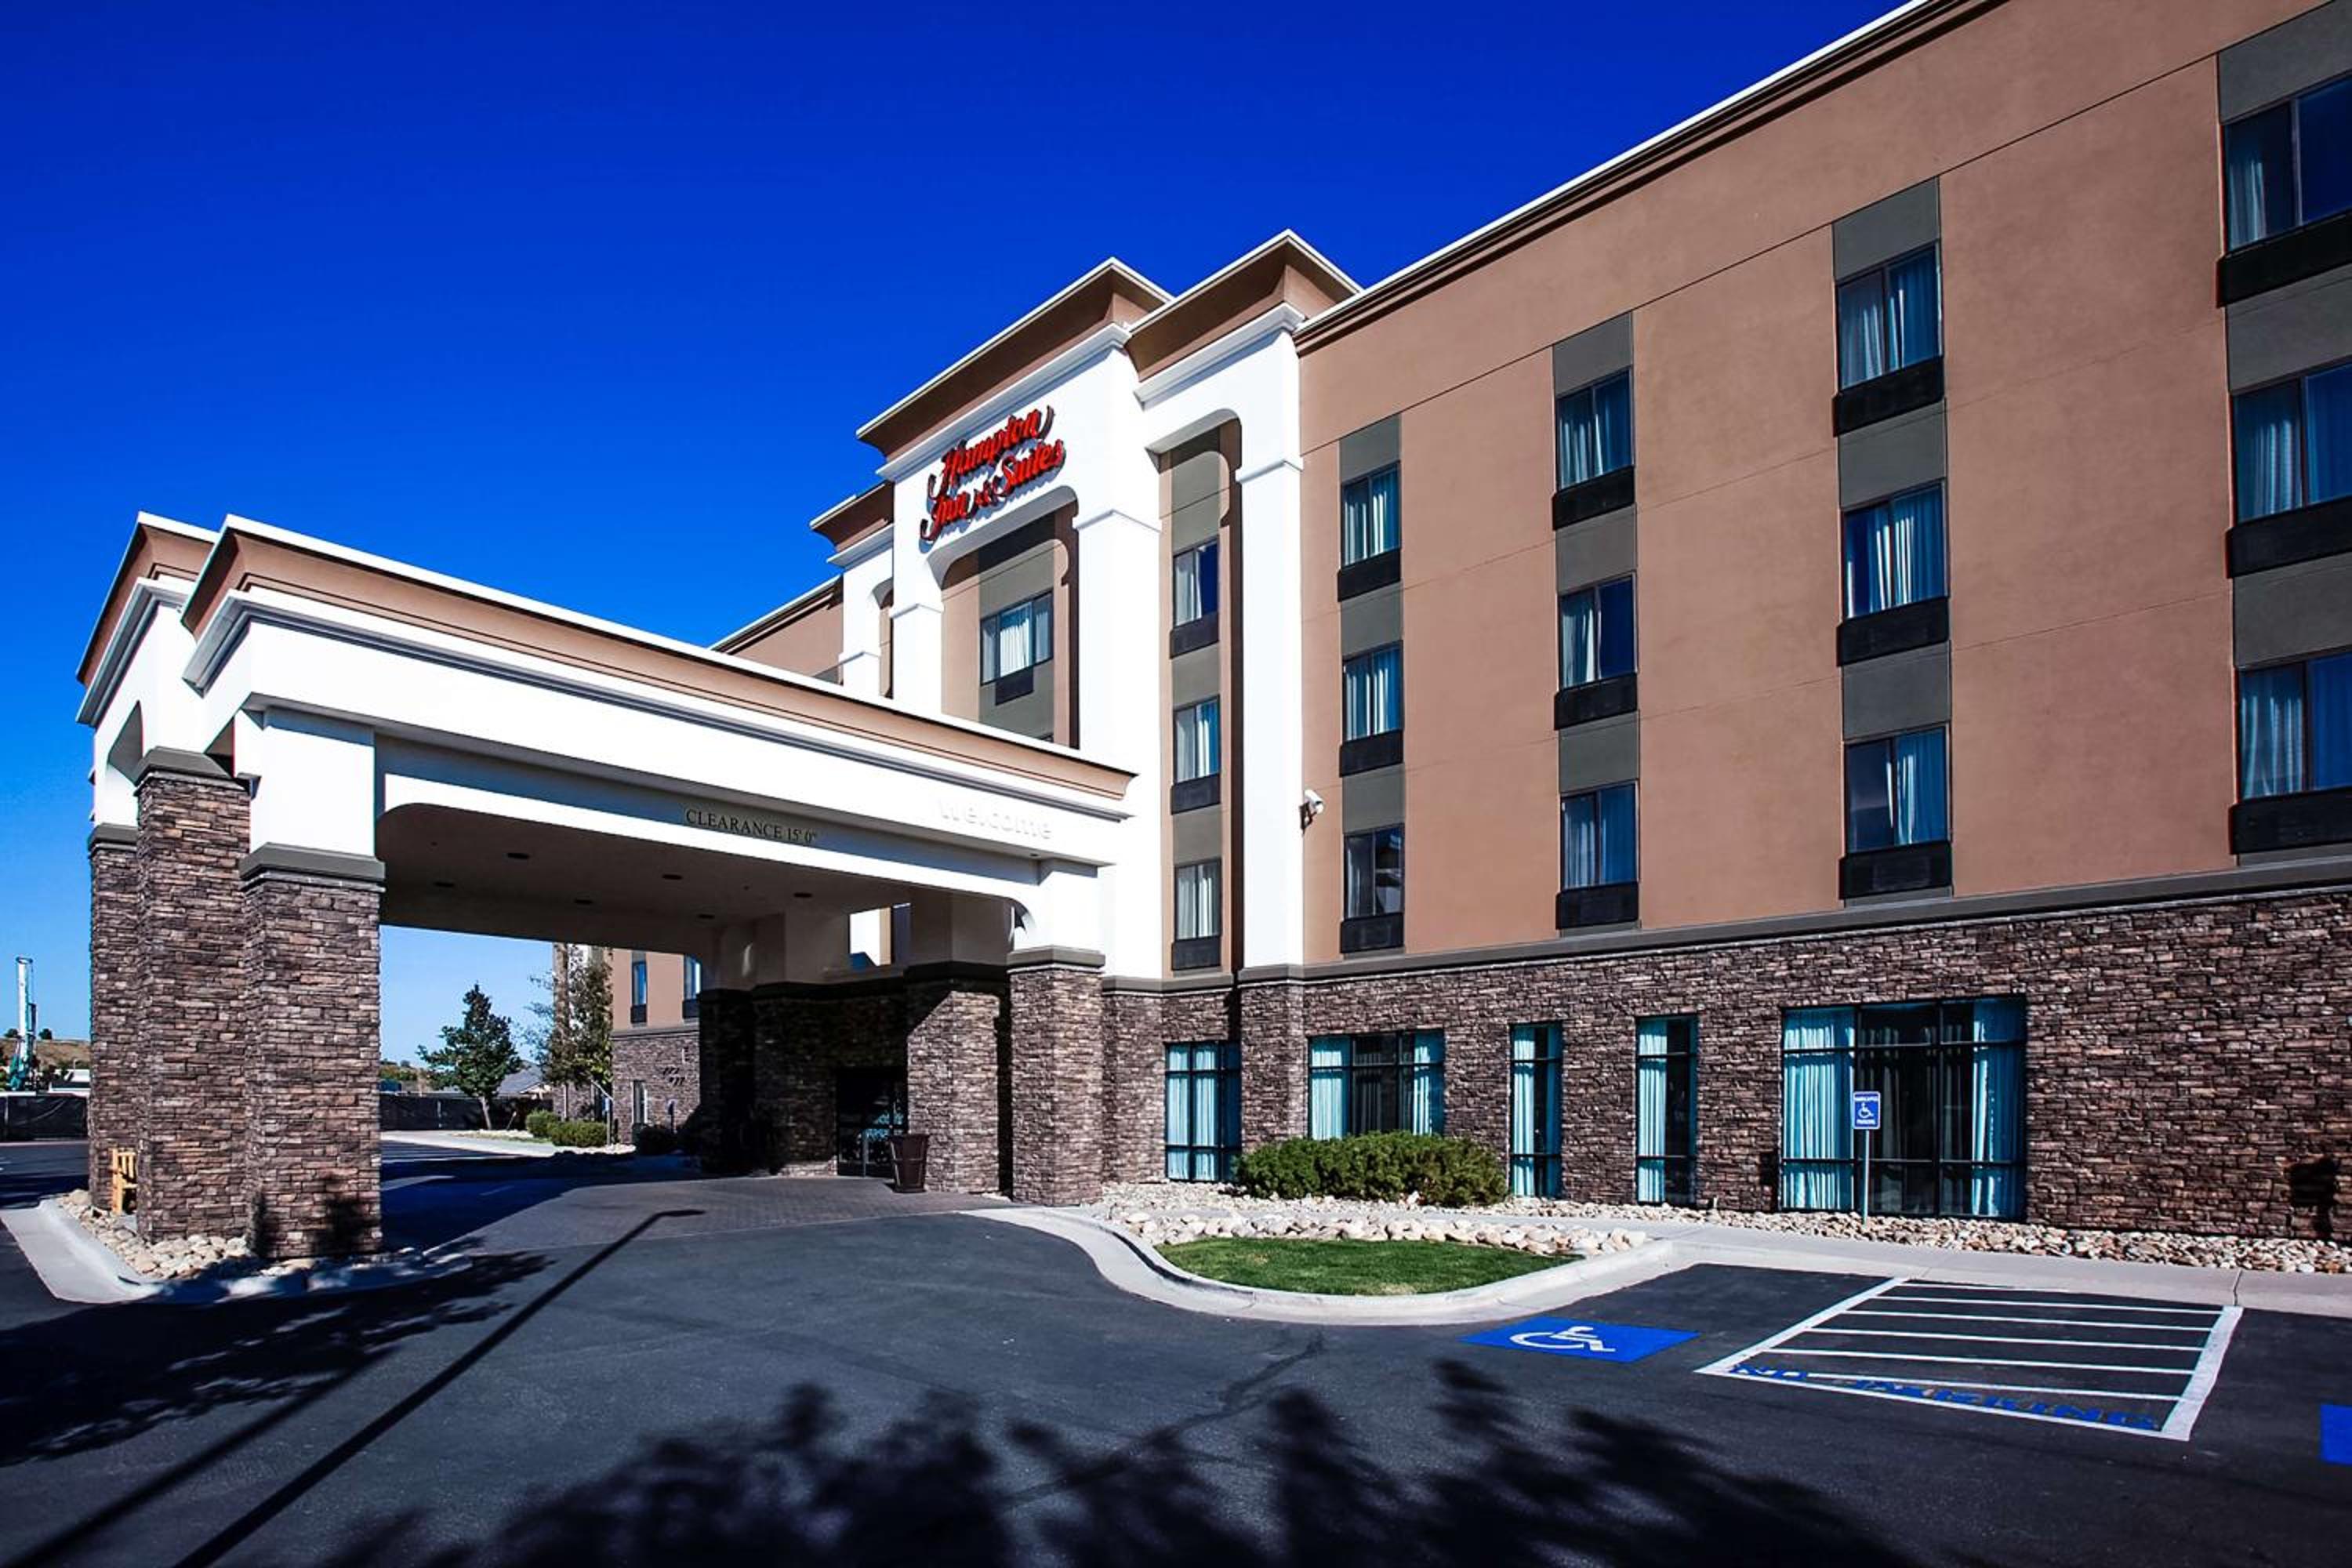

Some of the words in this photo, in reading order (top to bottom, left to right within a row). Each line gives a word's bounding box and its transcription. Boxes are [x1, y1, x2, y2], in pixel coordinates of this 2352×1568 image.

[920, 491, 979, 540] Inn
[992, 438, 1066, 498] Suites
[928, 405, 1055, 500] Hampton
[686, 808, 782, 839] CLEARANCE
